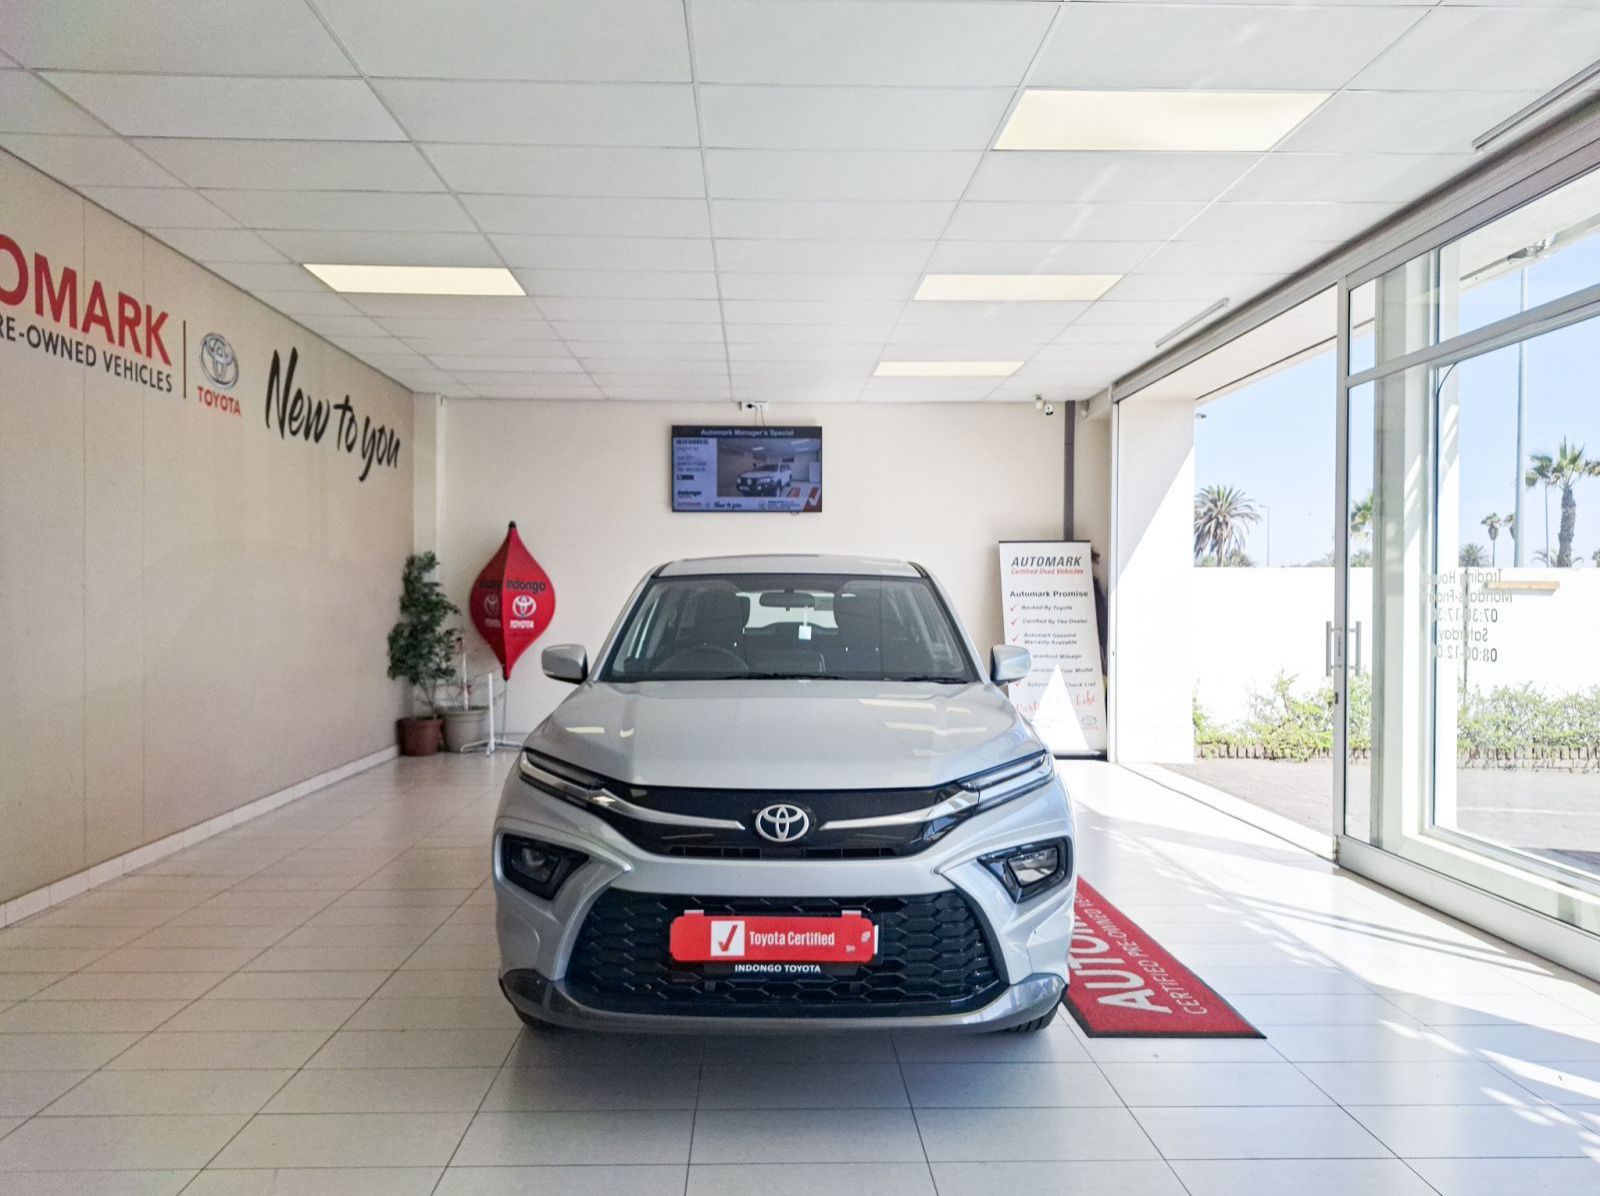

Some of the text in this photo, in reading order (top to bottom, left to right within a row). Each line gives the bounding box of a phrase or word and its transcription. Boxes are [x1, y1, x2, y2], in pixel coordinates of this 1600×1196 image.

[103, 350, 173, 393] VEHICLES
[197, 386, 242, 416] TOYOTA
[265, 347, 401, 482] New to you
[700, 428, 733, 436] Automark
[770, 428, 794, 438] Special
[1011, 556, 1083, 567] AUTOMARK
[1010, 590, 1089, 598] Automark Promise
[749, 931, 835, 947] Toyota Certified
[734, 963, 822, 974] INDONGO TOYOTA
[1138, 959, 1208, 1015] CERTIFIED
